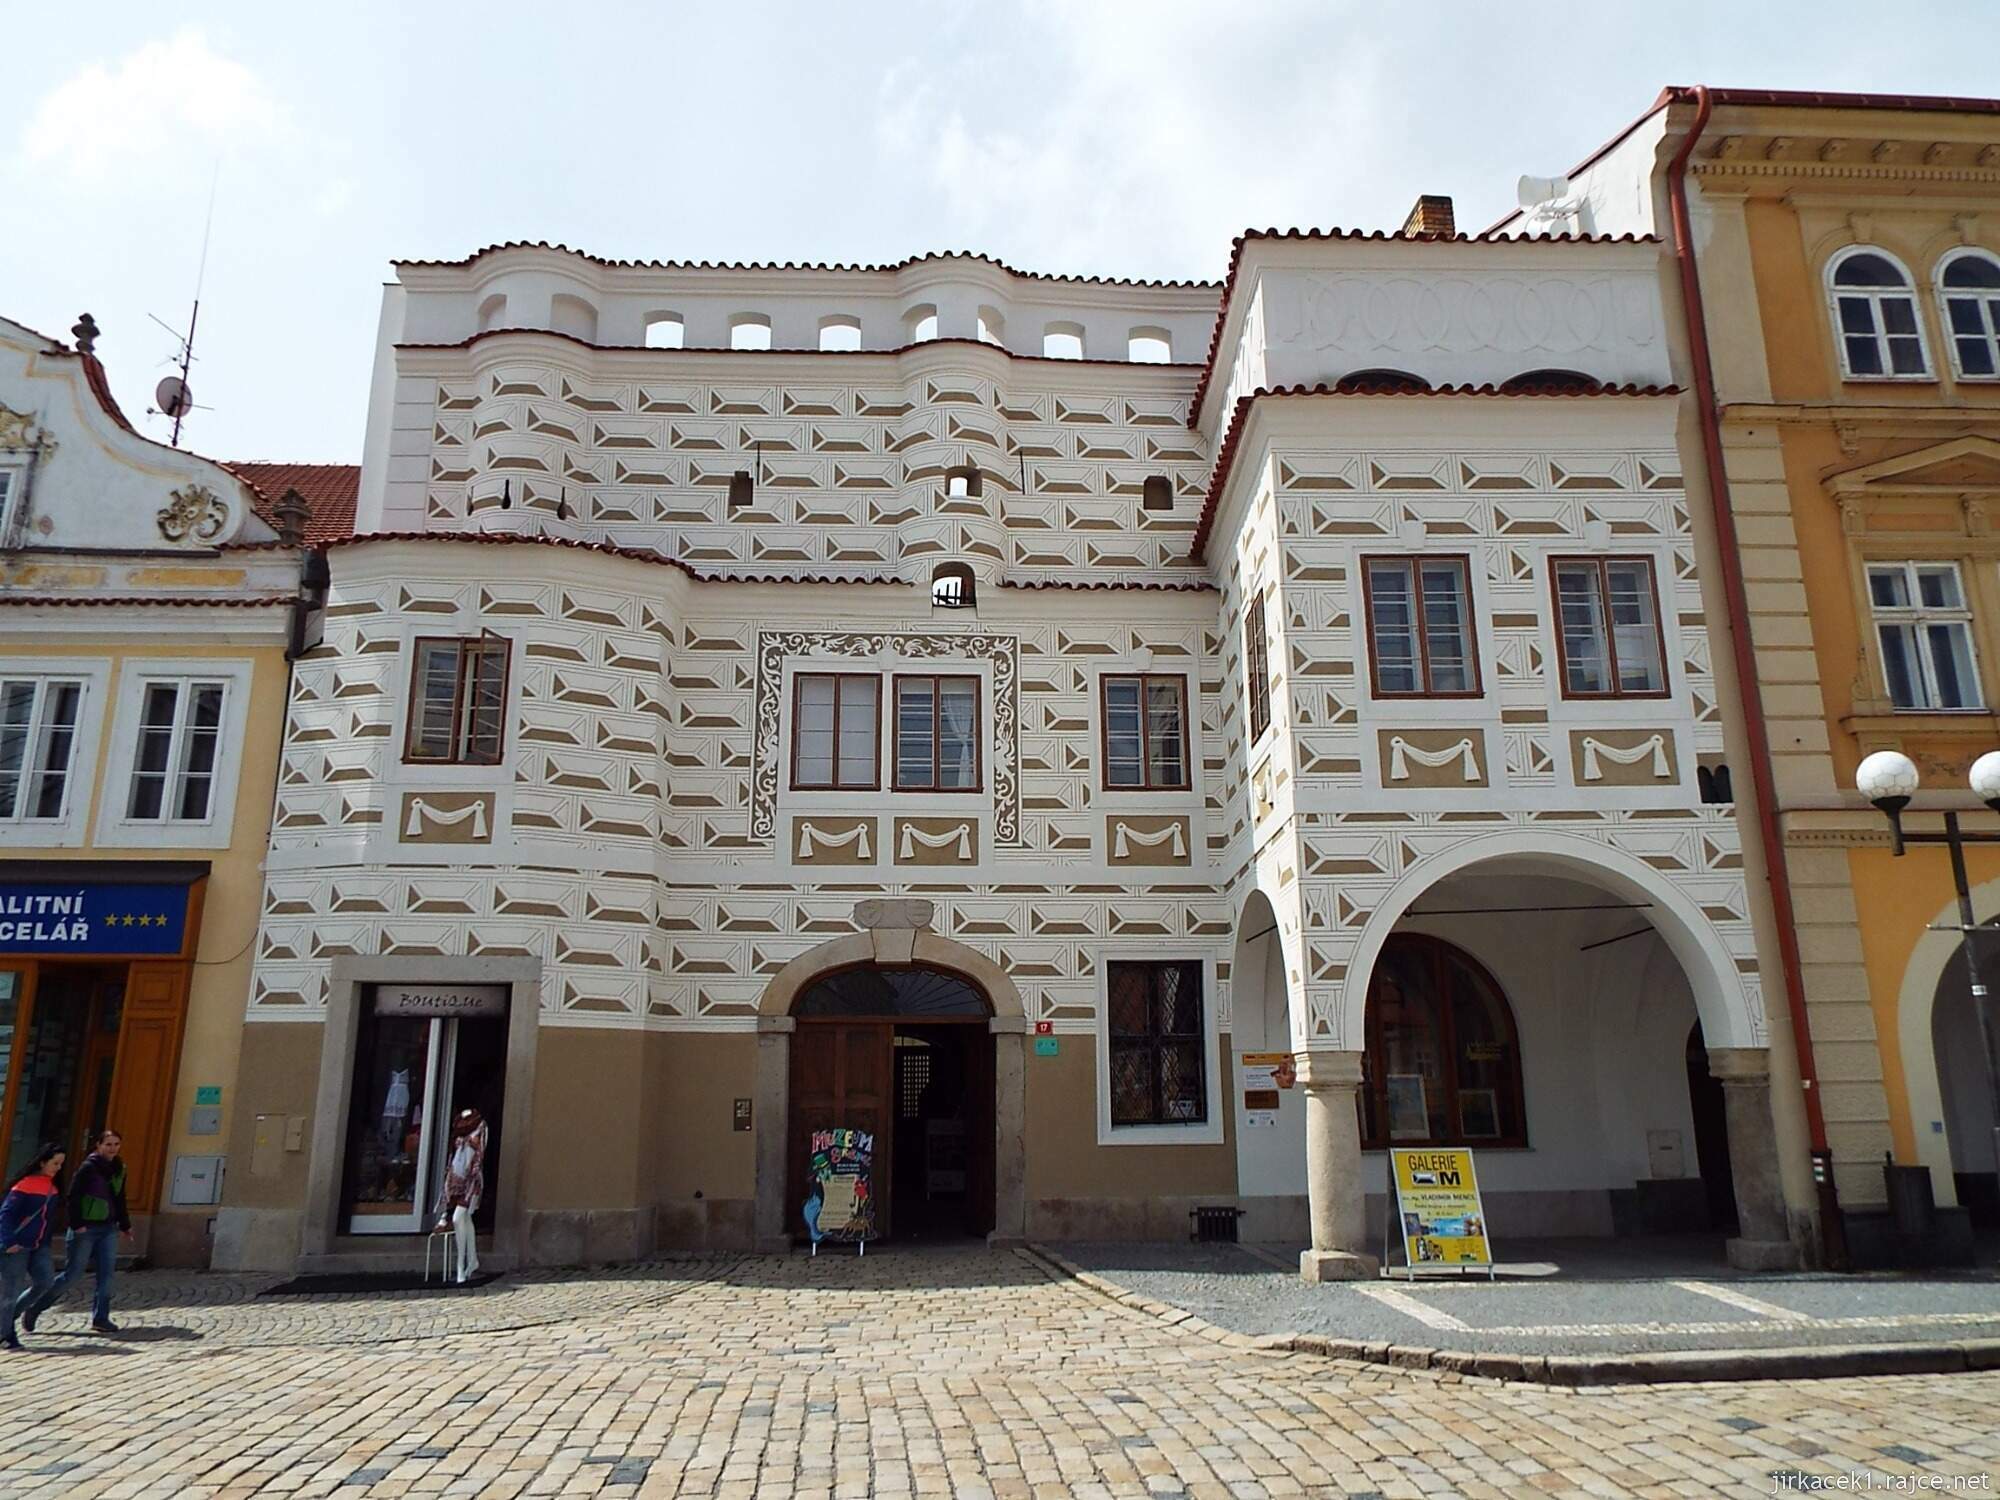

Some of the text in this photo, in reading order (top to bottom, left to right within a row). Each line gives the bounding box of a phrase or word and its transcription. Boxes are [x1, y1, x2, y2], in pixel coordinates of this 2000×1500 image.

[0, 890, 85, 914] LITNÍ
[1040, 1023, 1048, 1032] 17
[811, 1128, 874, 1154] MUZEUM
[1407, 1154, 1459, 1171] GALERIE
[1439, 1171, 1461, 1185] M
